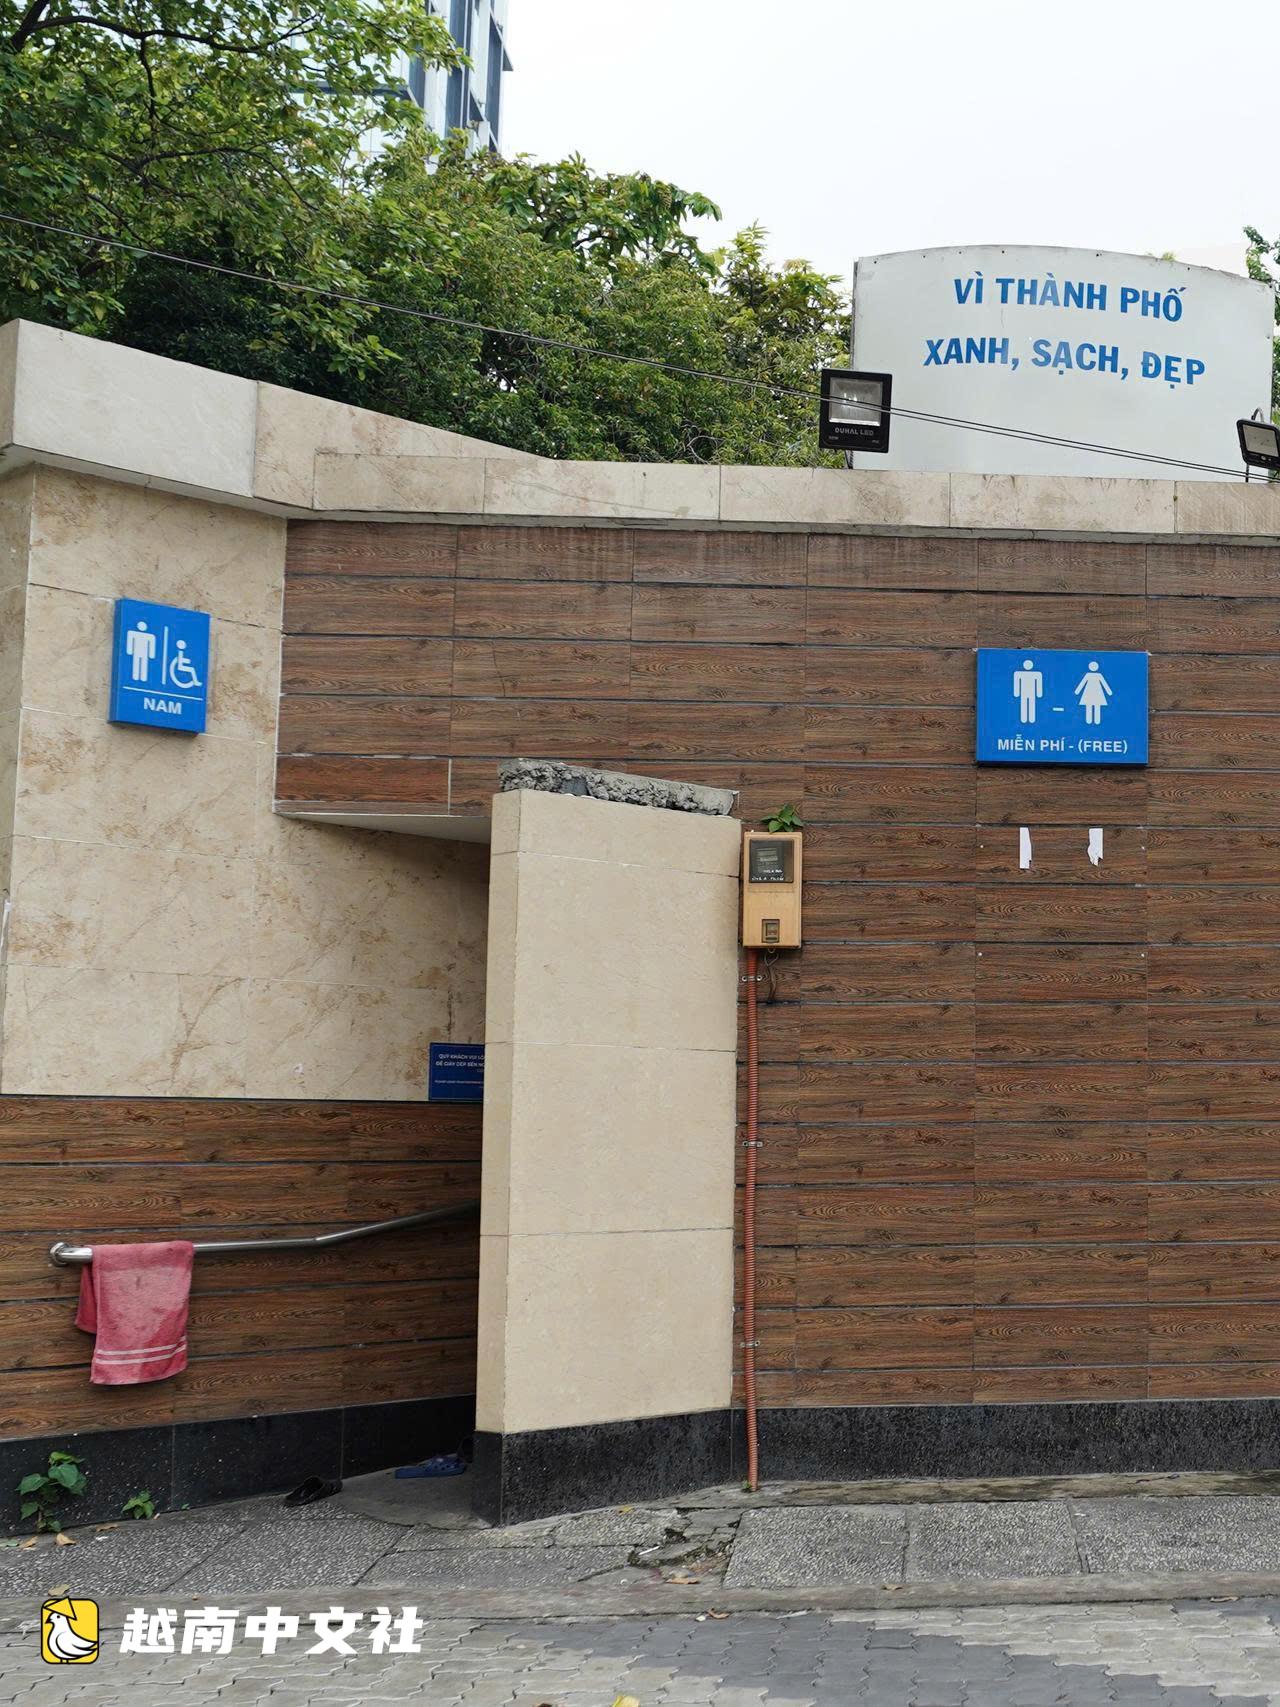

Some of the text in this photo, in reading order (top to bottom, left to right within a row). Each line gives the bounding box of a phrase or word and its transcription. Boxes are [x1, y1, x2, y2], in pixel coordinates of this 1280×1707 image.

[953, 271, 1188, 322] VÌ THÀNH PHỐ
[922, 337, 1206, 390] XANH, SẠCH, ĐẸP
[834, 427, 859, 435] DUHAL
[143, 697, 183, 715] NAM
[997, 734, 1036, 752] MIỄN
[1040, 736, 1066, 752] PHÍ
[1077, 738, 1129, 754] (FREE)
